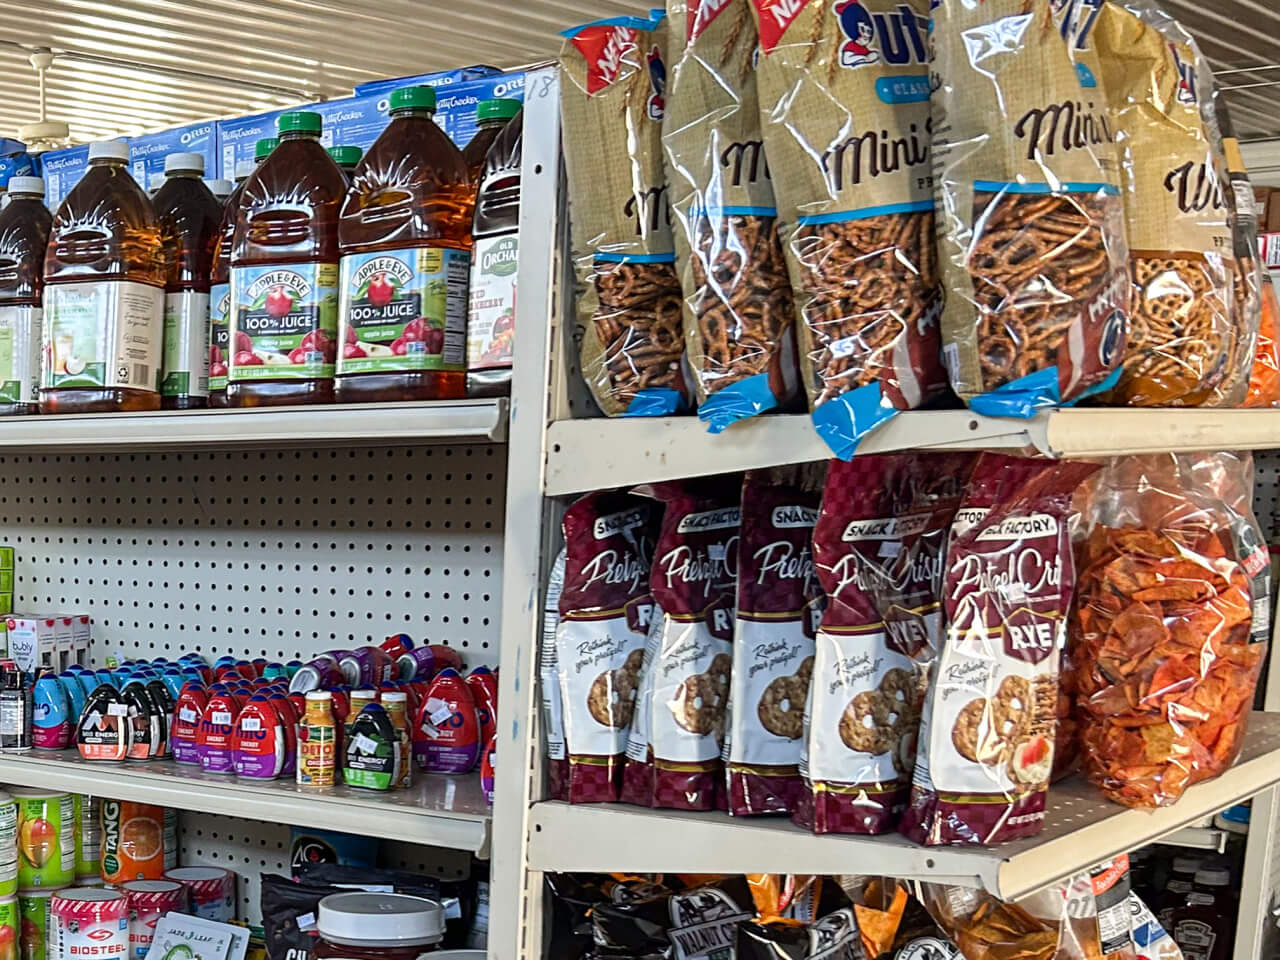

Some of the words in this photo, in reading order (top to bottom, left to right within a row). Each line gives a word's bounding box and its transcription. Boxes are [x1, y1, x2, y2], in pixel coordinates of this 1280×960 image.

[181, 126, 211, 144] OREO
[1014, 100, 1104, 160] Mini
[822, 123, 926, 191] Mini
[500, 241, 512, 249] OLD
[349, 307, 381, 320] 100%
[383, 304, 413, 318] JUICE
[246, 318, 278, 330] 100%
[279, 315, 312, 328] JUICE
[847, 523, 887, 536] SNACK
[1012, 623, 1053, 650] RYE
[105, 801, 120, 854] TANG
[70, 944, 126, 954] BIOSTEEL
